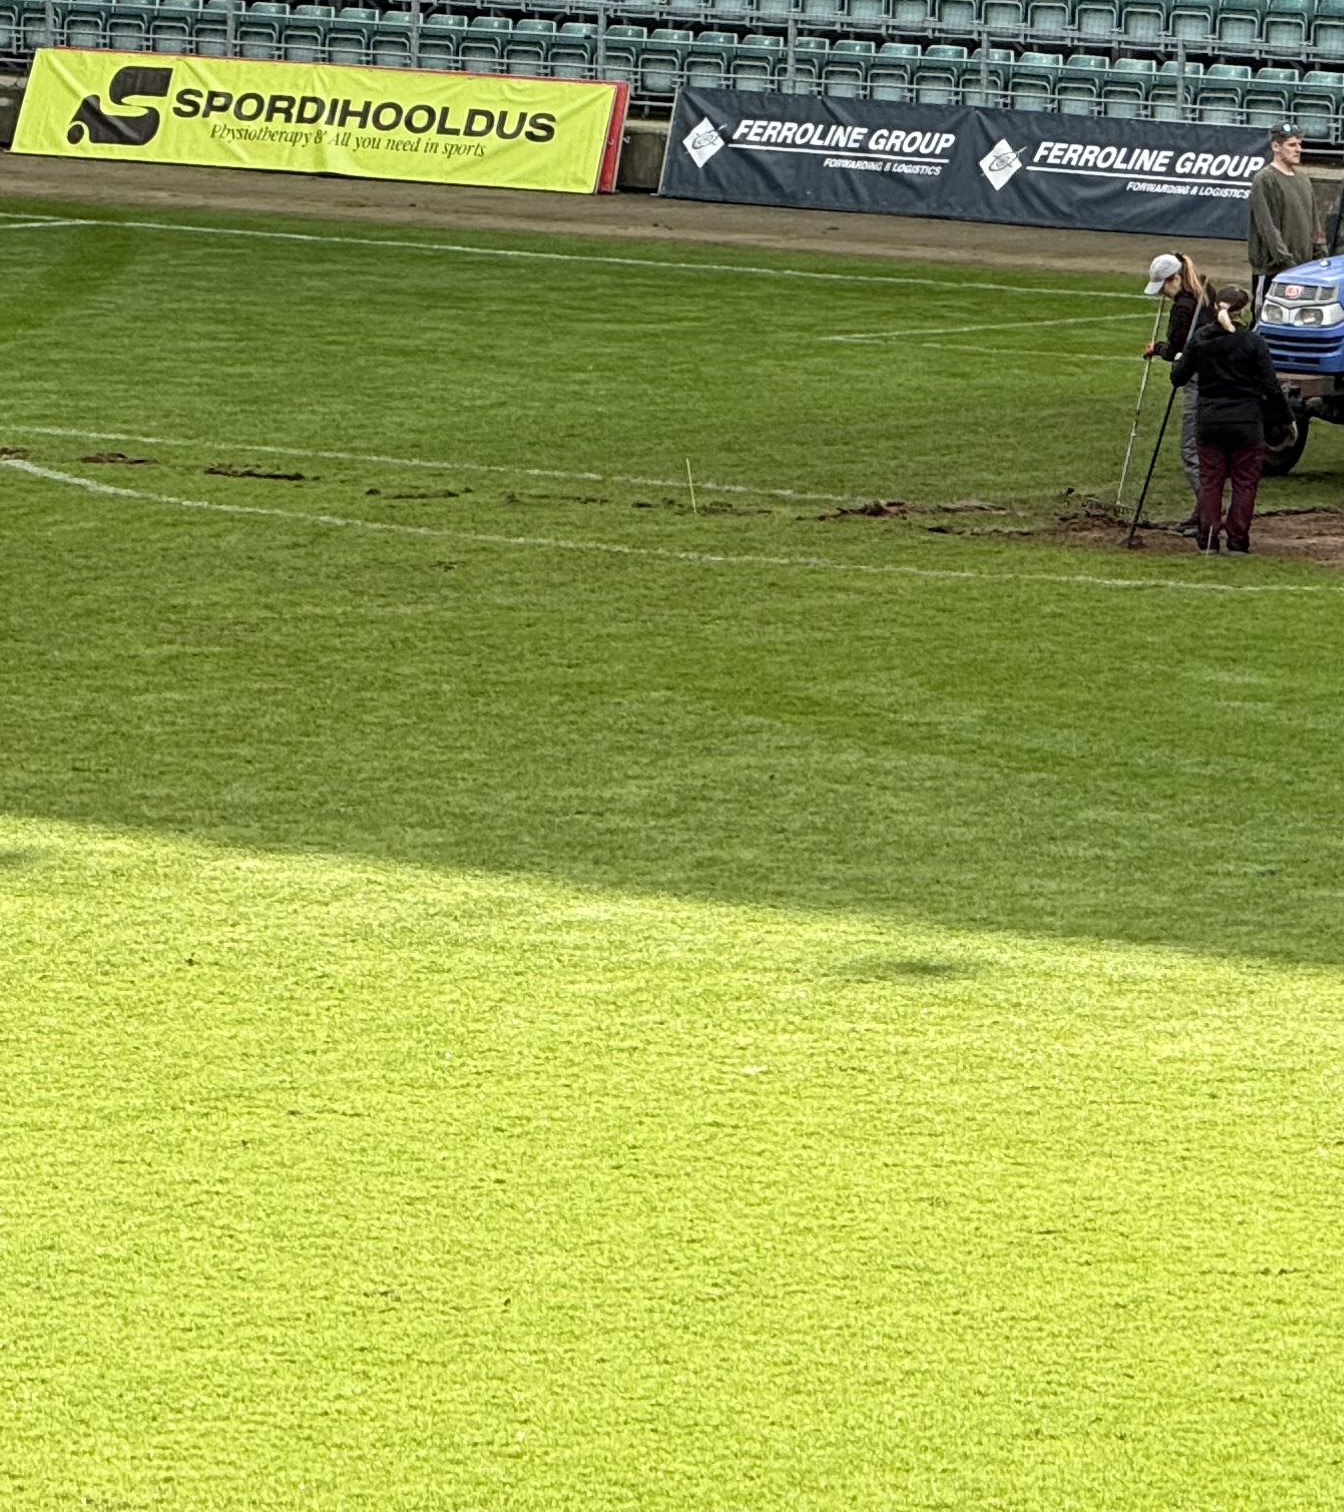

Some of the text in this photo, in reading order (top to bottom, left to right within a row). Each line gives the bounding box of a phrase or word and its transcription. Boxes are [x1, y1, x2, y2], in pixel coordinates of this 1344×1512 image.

[172, 87, 557, 143] SPORDIHOOLDUS
[210, 124, 311, 148] Physiotherapy
[327, 132, 350, 148] All
[352, 134, 383, 152] you
[384, 138, 421, 154] need
[423, 140, 440, 155] in
[441, 142, 487, 159] sports
[732, 119, 957, 155] FERROLINE GROUP
[823, 157, 884, 172] FORWARDING
[891, 162, 942, 177] LOGISTICS
[1033, 141, 1266, 179] FERROLINE GROUP
[1125, 180, 1191, 196] FORWARDING
[1198, 185, 1251, 200] LOGISTICS
